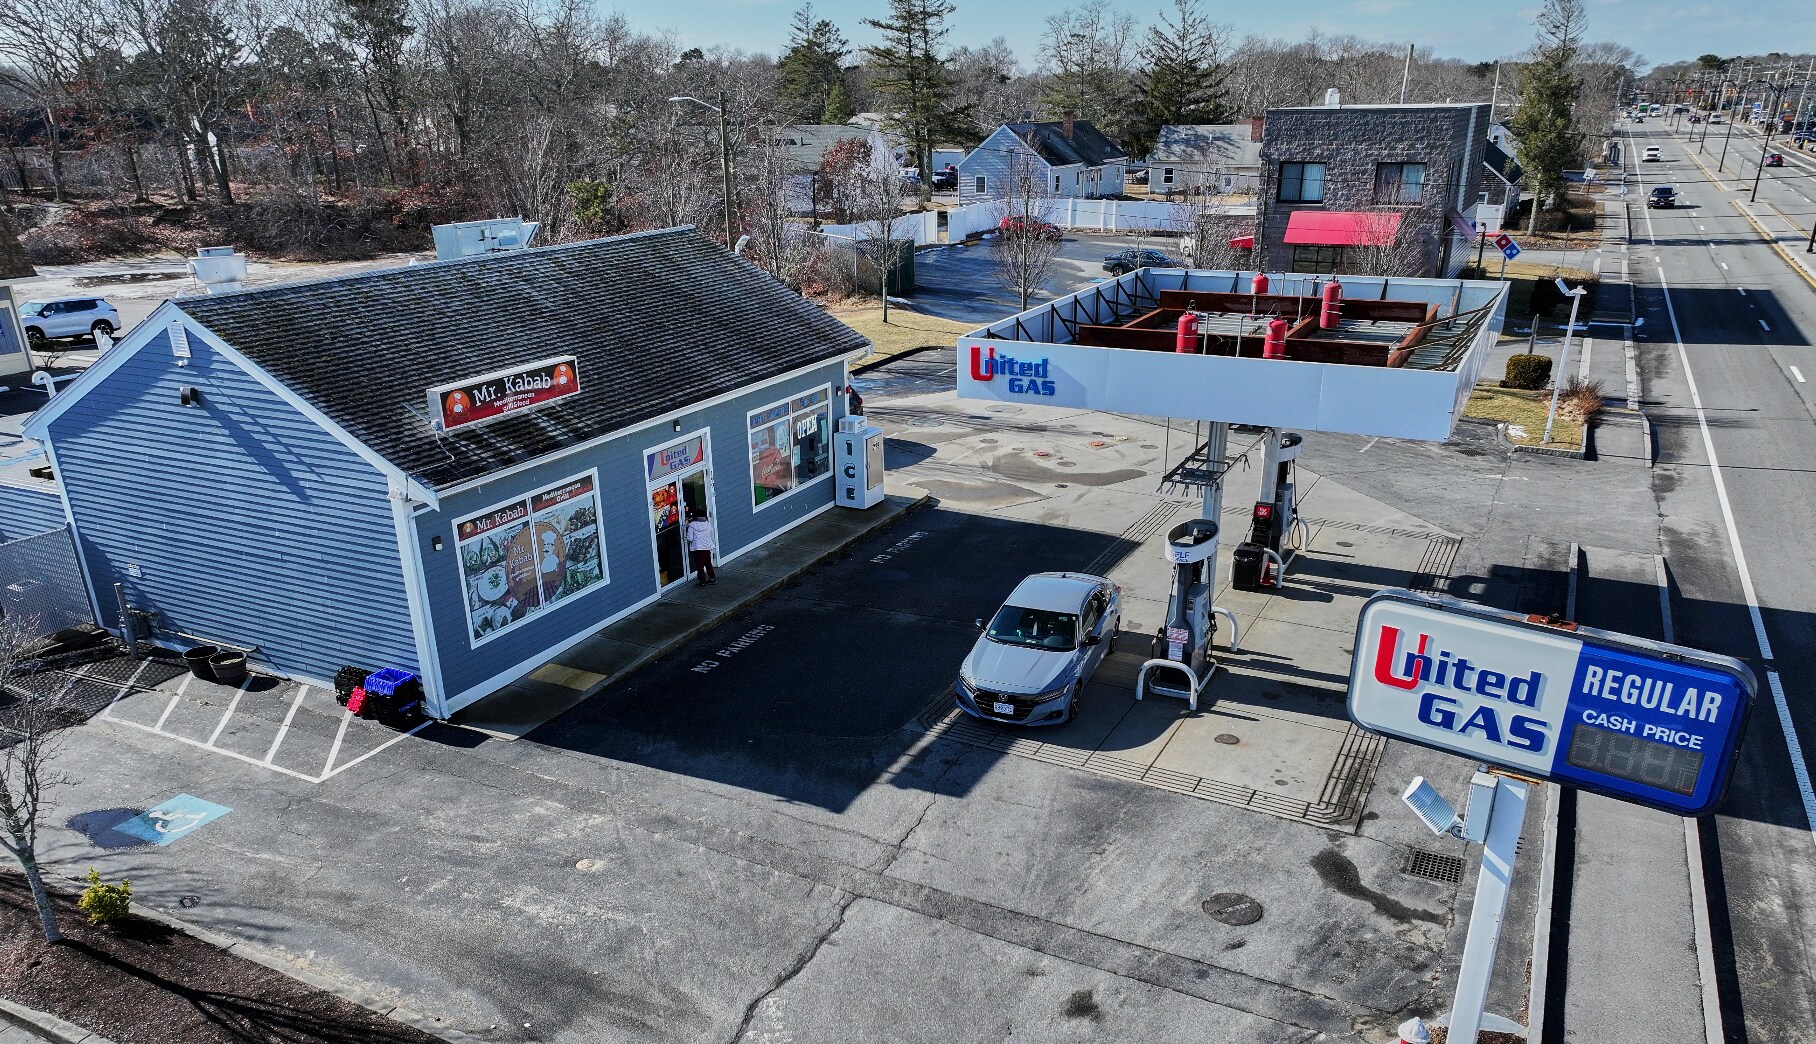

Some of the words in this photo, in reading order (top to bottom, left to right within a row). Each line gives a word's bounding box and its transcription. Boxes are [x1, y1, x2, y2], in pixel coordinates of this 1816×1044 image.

[970, 346, 1048, 381] United
[472, 385, 501, 407] Mr.
[504, 373, 551, 395] Kabab
[1008, 377, 1055, 396] GAS
[797, 414, 818, 439] OPEN
[660, 446, 688, 467] United
[669, 456, 691, 471] GAS
[476, 520, 493, 533] Mr.
[494, 506, 524, 525] Kabab
[509, 553, 533, 569] Kabab
[512, 544, 527, 557] Mr.
[1170, 550, 1190, 559] SELF
[690, 660, 720, 673] NO
[716, 624, 775, 658] PARKING
[1374, 625, 1542, 708] United
[1582, 664, 1723, 724] REGULAR
[1418, 692, 1548, 752] GAS
[1582, 709, 1637, 734] CASH
[1643, 723, 1704, 749] PRICE
